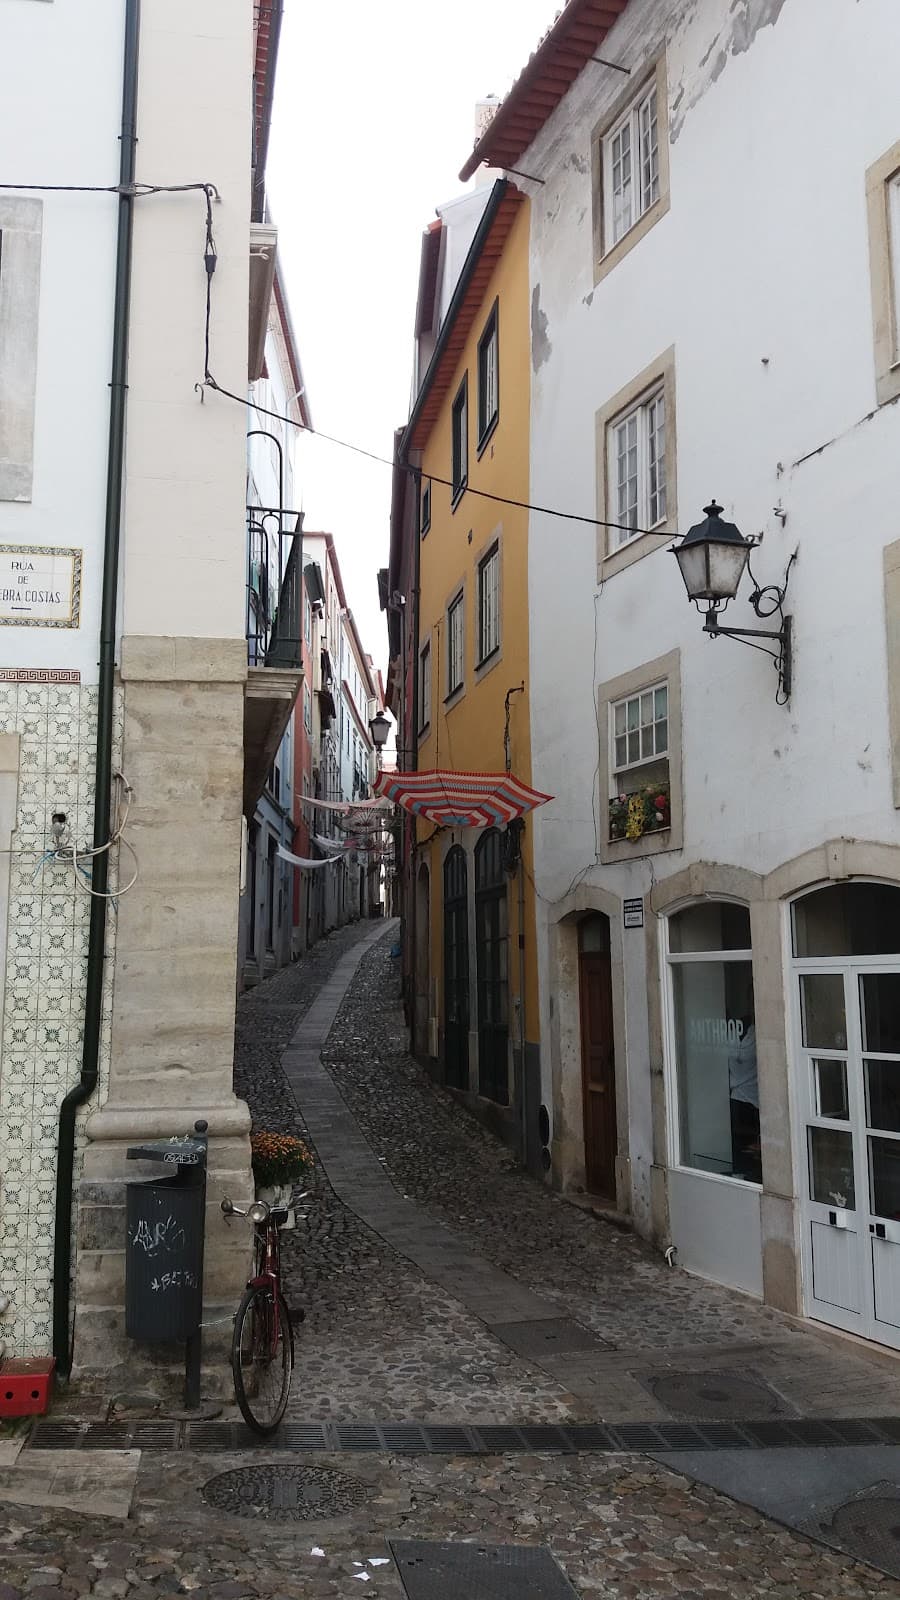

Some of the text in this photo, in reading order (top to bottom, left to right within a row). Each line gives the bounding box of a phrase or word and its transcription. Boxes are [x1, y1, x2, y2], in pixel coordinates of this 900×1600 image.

[11, 561, 34, 571] RUA
[17, 575, 29, 584] DE
[25, 590, 61, 604] COSTAS
